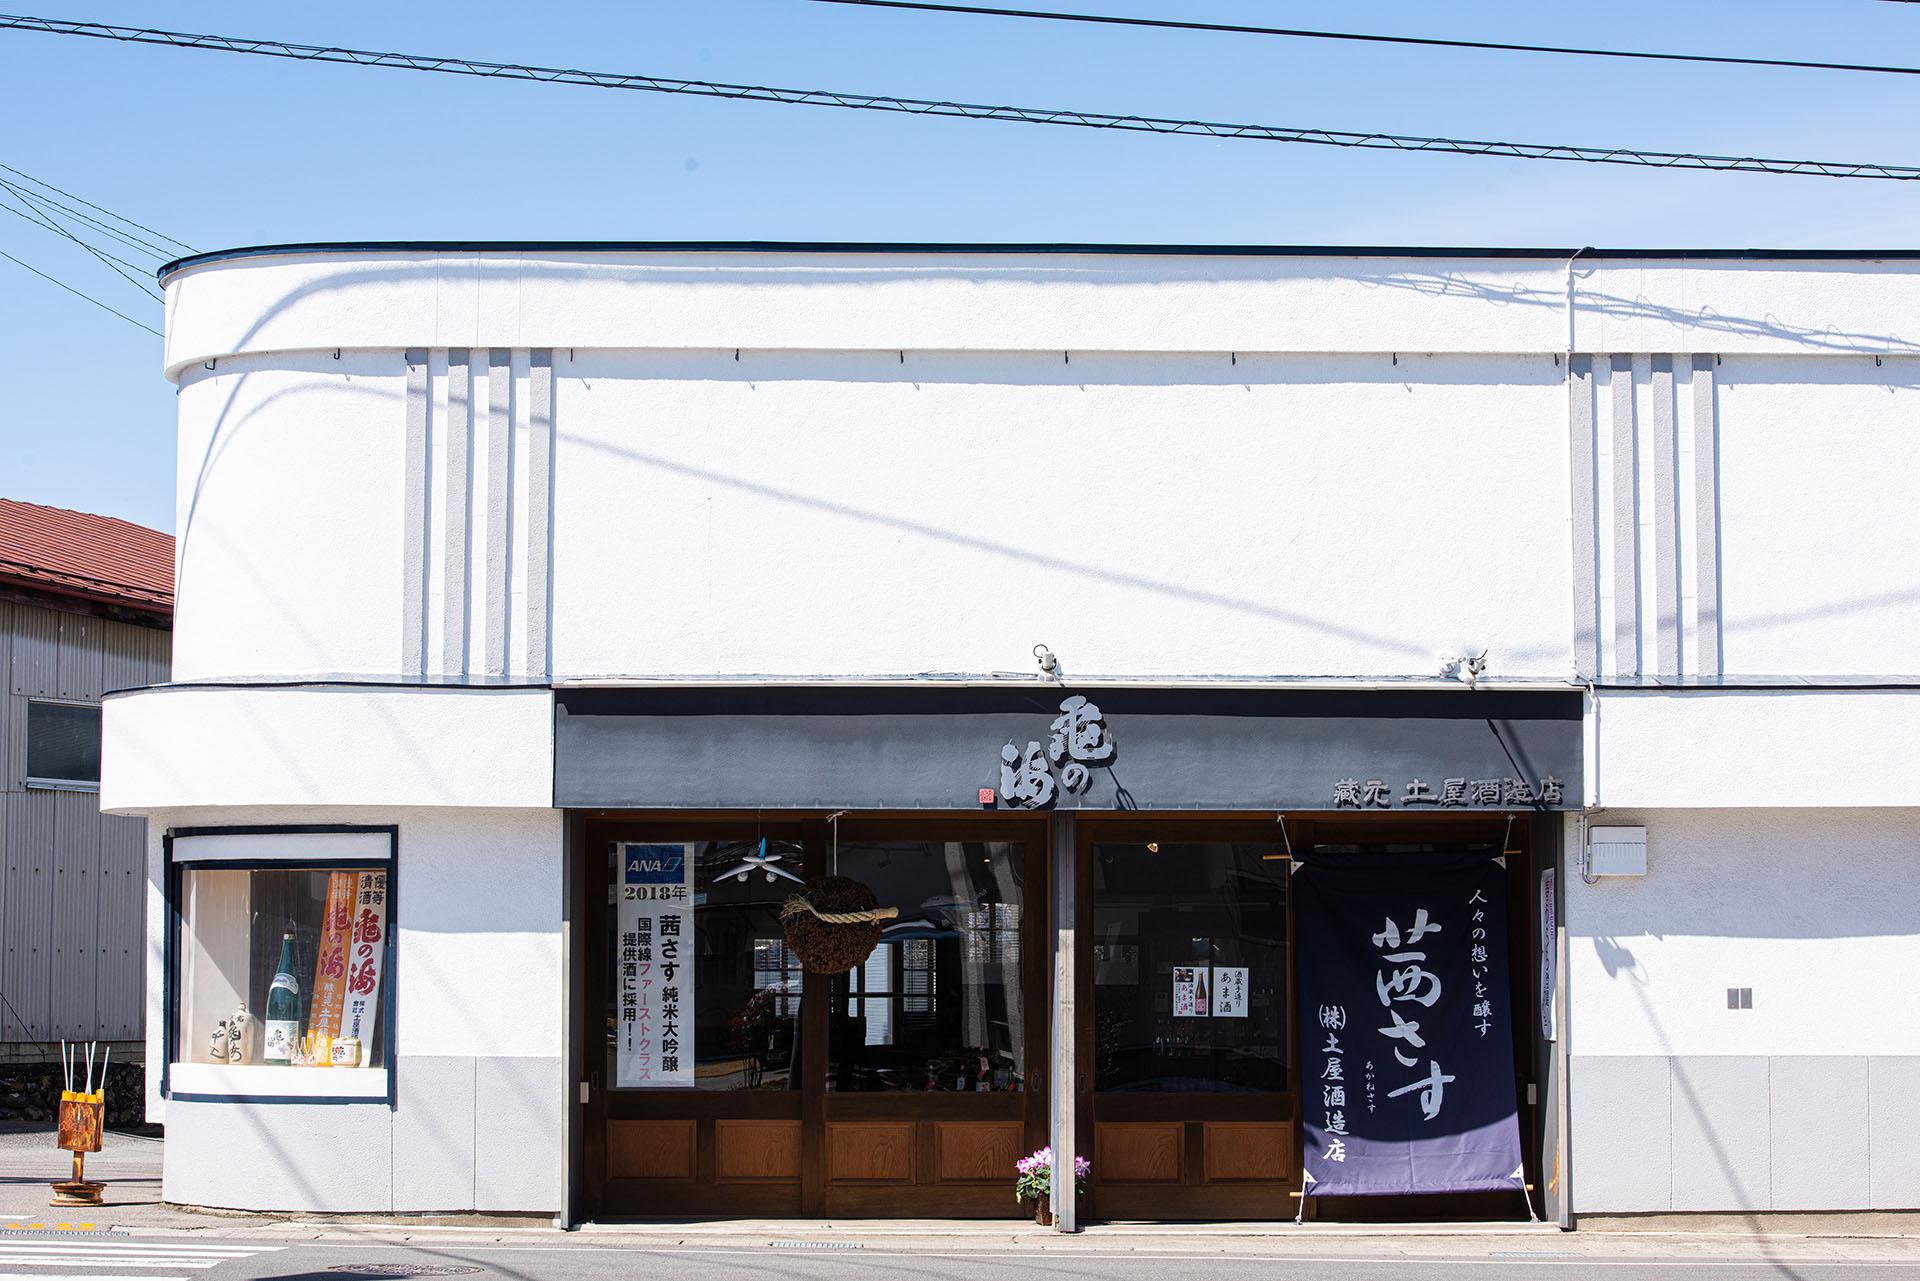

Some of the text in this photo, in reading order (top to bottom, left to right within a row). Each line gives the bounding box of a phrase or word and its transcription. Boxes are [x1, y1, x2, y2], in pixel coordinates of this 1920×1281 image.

[1400, 775, 1563, 805] 土屋酒造店
[627, 859, 662, 872] ANA
[637, 917, 652, 1081] 国際線ファーストクラス
[659, 914, 682, 1072] 茜さす 純米大吟醸
[1219, 971, 1232, 1013] あま酒
[1372, 908, 1456, 1121] 茜さす
[1365, 1060, 1376, 1113] あかねさす
